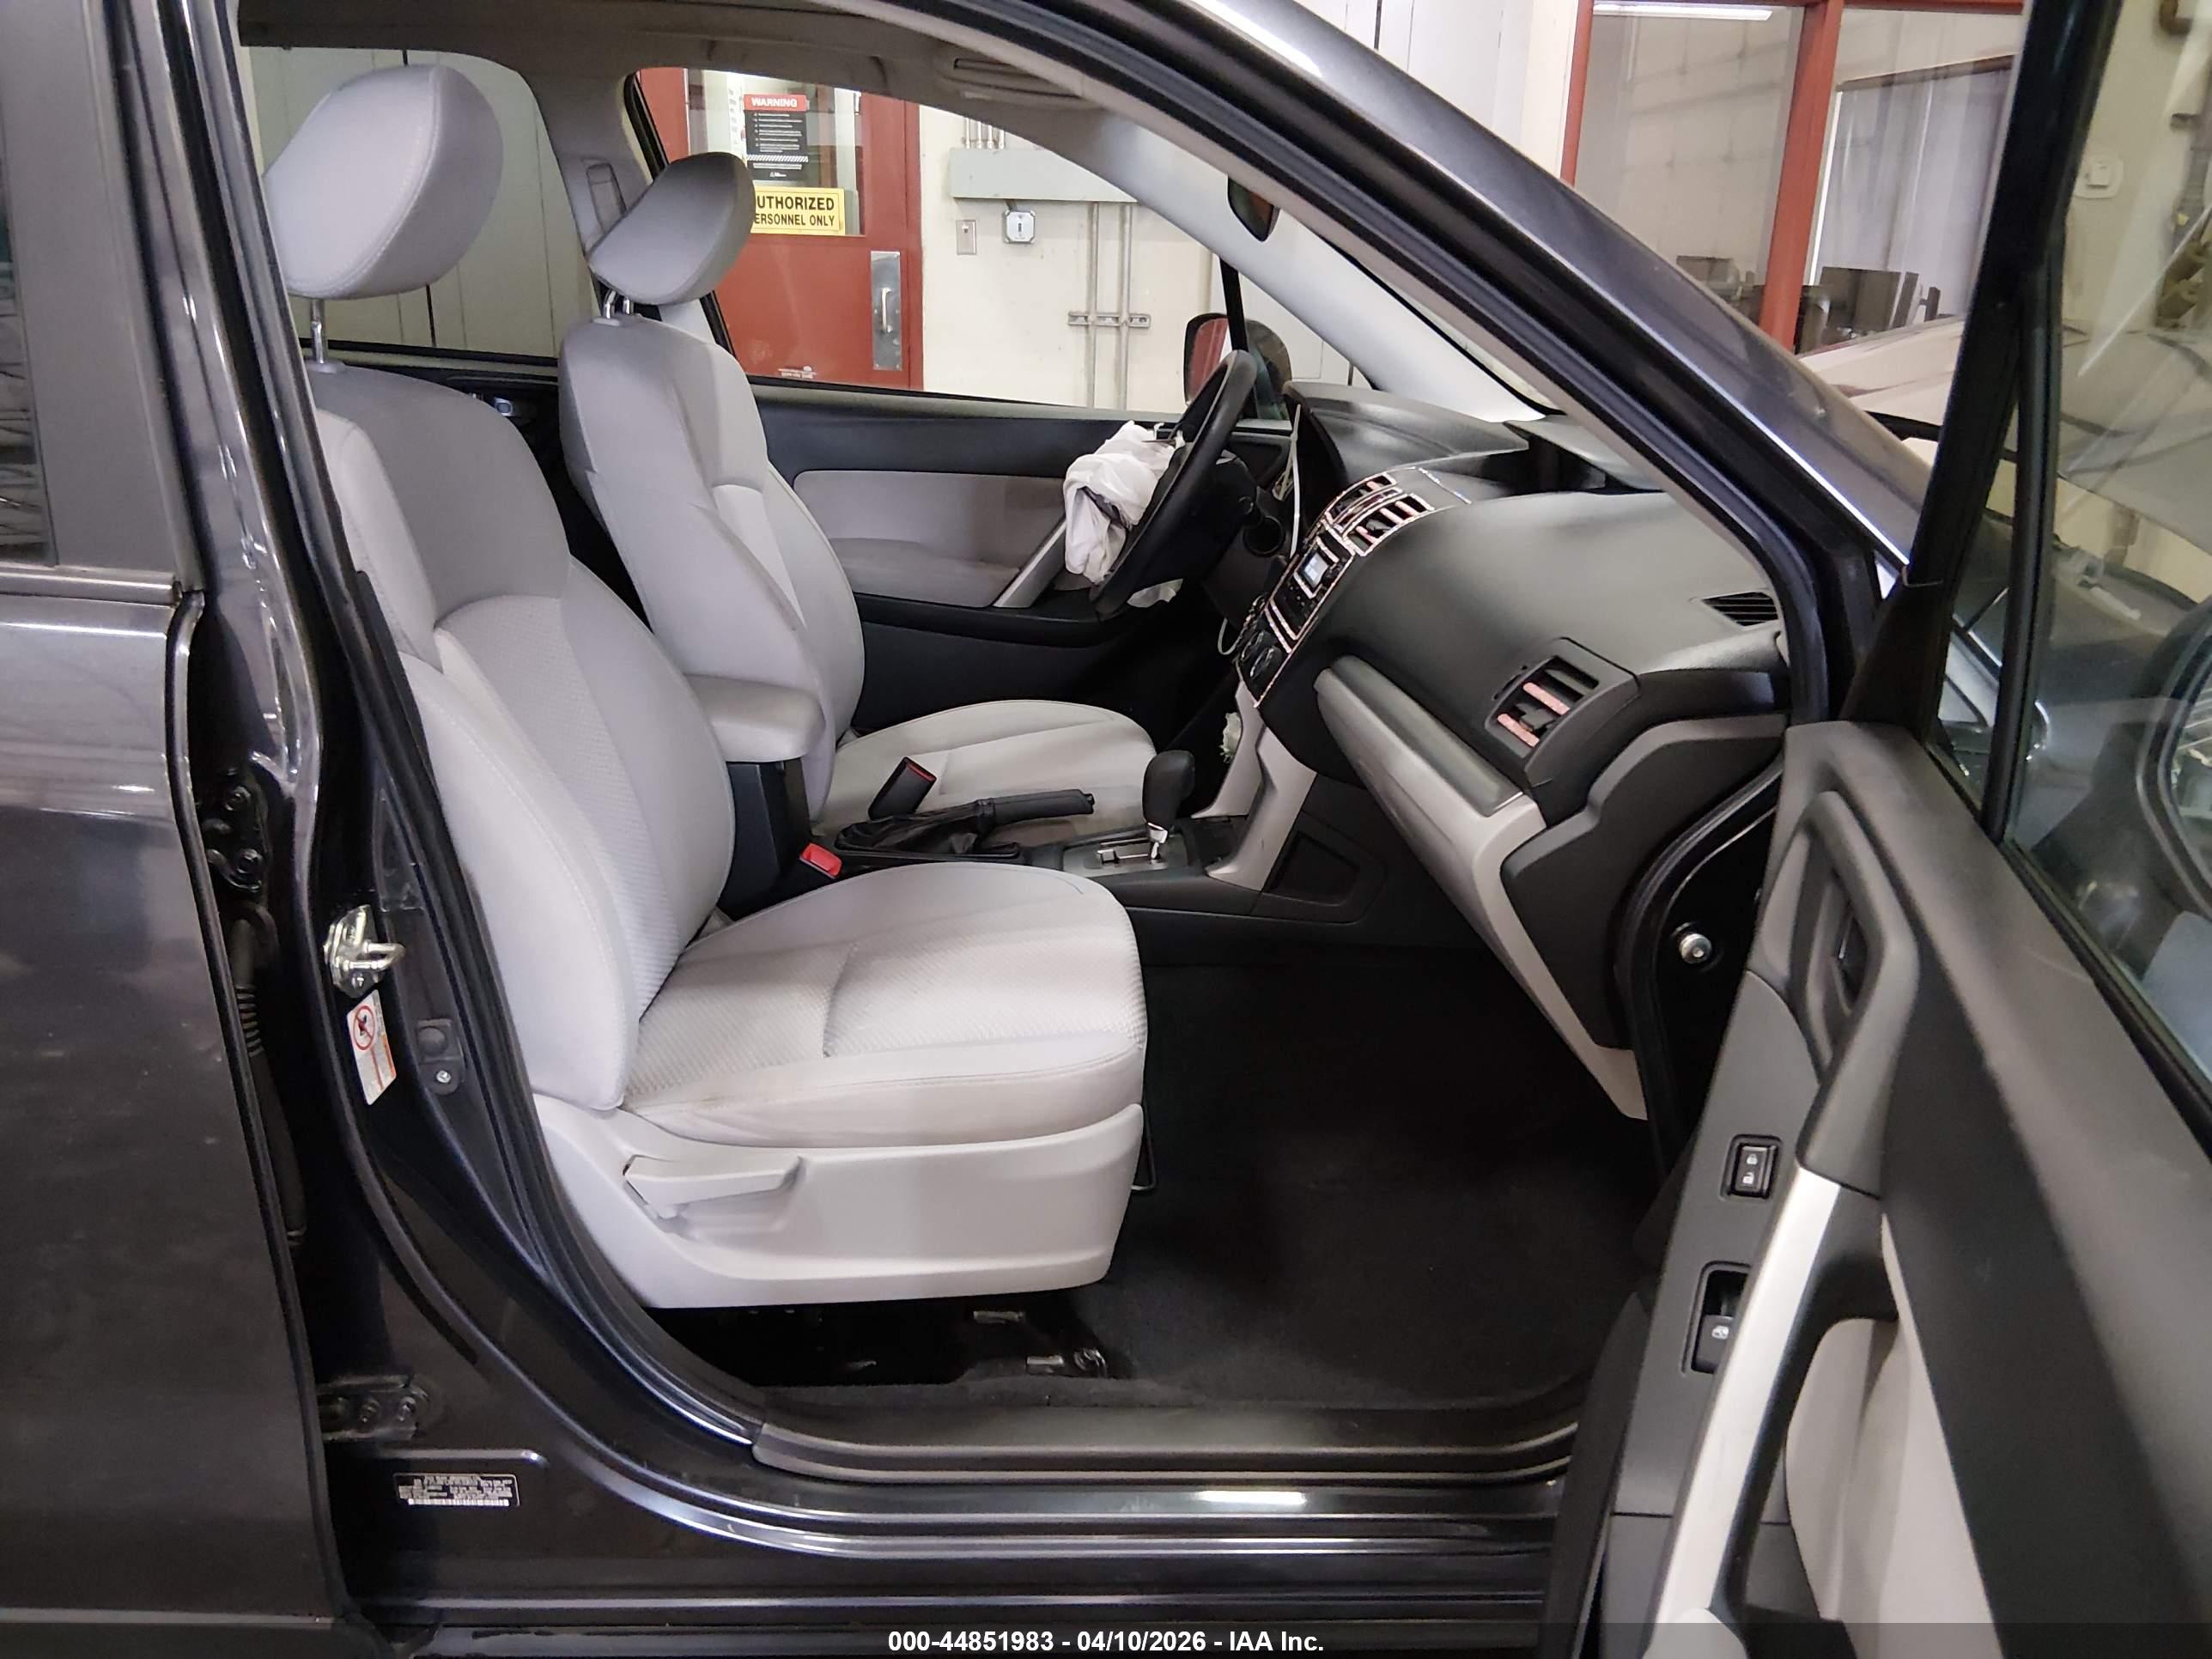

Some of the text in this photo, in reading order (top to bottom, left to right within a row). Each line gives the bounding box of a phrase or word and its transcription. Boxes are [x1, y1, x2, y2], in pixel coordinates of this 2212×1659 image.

[751, 97, 798, 107] WARNING
[757, 195, 835, 210] UTHORIZED
[754, 213, 835, 227] ERSONNEL ONLY
